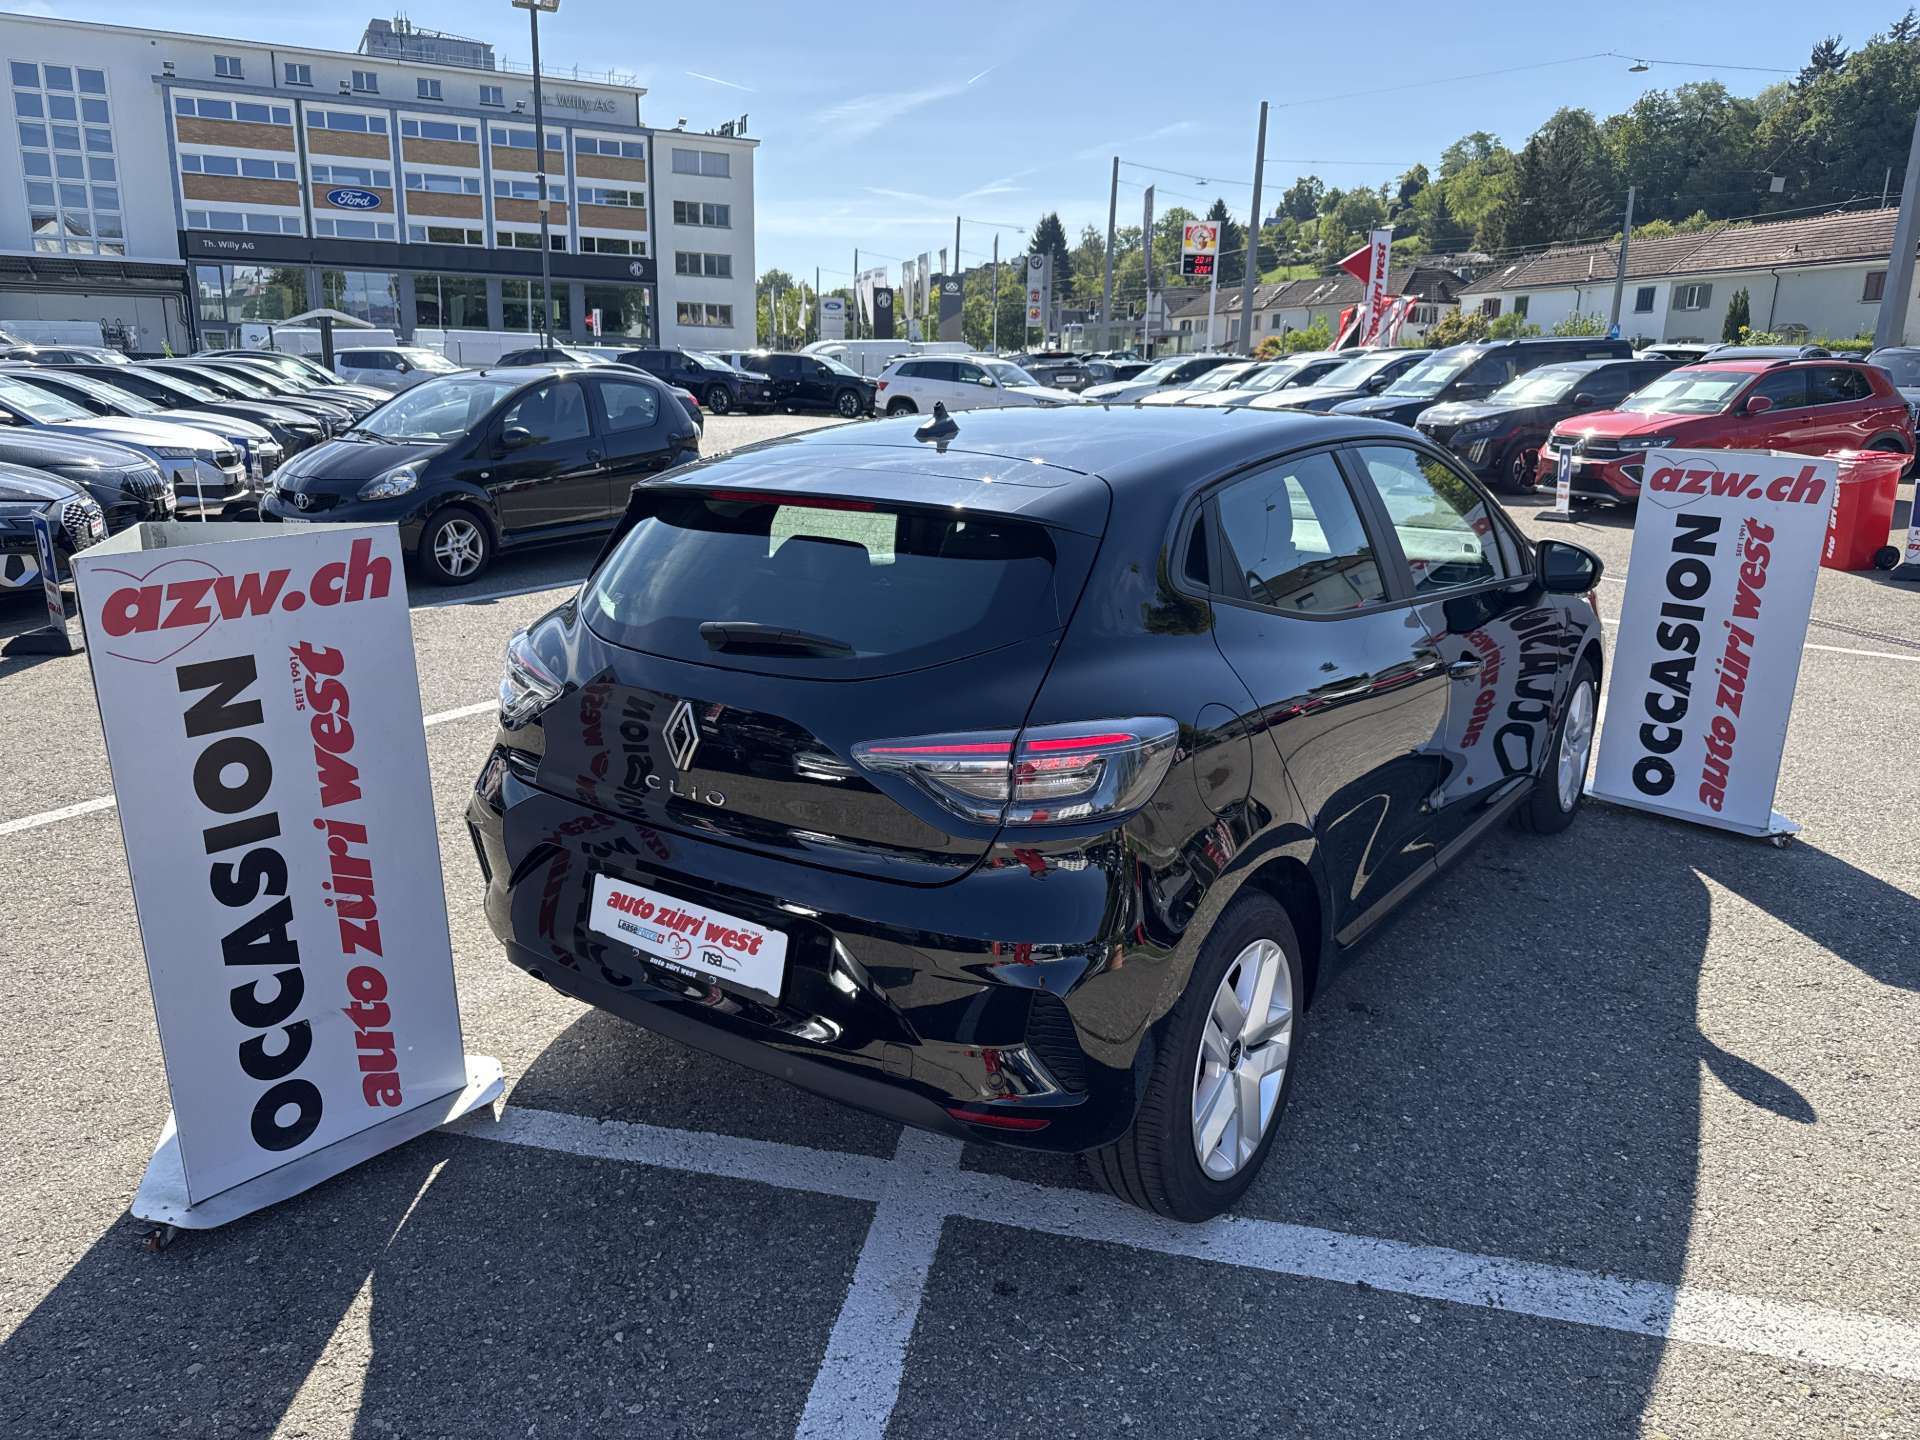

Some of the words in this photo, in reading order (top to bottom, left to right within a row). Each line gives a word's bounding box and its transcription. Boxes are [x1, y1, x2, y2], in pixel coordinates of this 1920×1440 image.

[557, 95, 590, 113] Willy
[594, 98, 616, 113] AG
[338, 190, 369, 207] Ford
[203, 240, 216, 248] Th.
[218, 241, 240, 250] Willy
[241, 242, 255, 250] AG
[1650, 465, 1827, 505] azw.ch
[102, 538, 391, 637] azw.ch
[1732, 516, 1775, 619] west
[289, 656, 302, 683] 1991
[1632, 513, 1722, 796] OCCASION
[1714, 620, 1755, 719] züri
[289, 641, 362, 808] west
[294, 688, 305, 712] SEIT
[645, 774, 725, 807] CLIO
[1699, 715, 1736, 812] auto
[176, 654, 323, 1151] OCCASION
[313, 819, 383, 957] züri
[607, 891, 654, 919] auto
[653, 908, 706, 936] züri
[704, 921, 763, 955] west
[650, 957, 665, 966] auto
[702, 951, 722, 967] nsa
[340, 965, 402, 1110] auto
